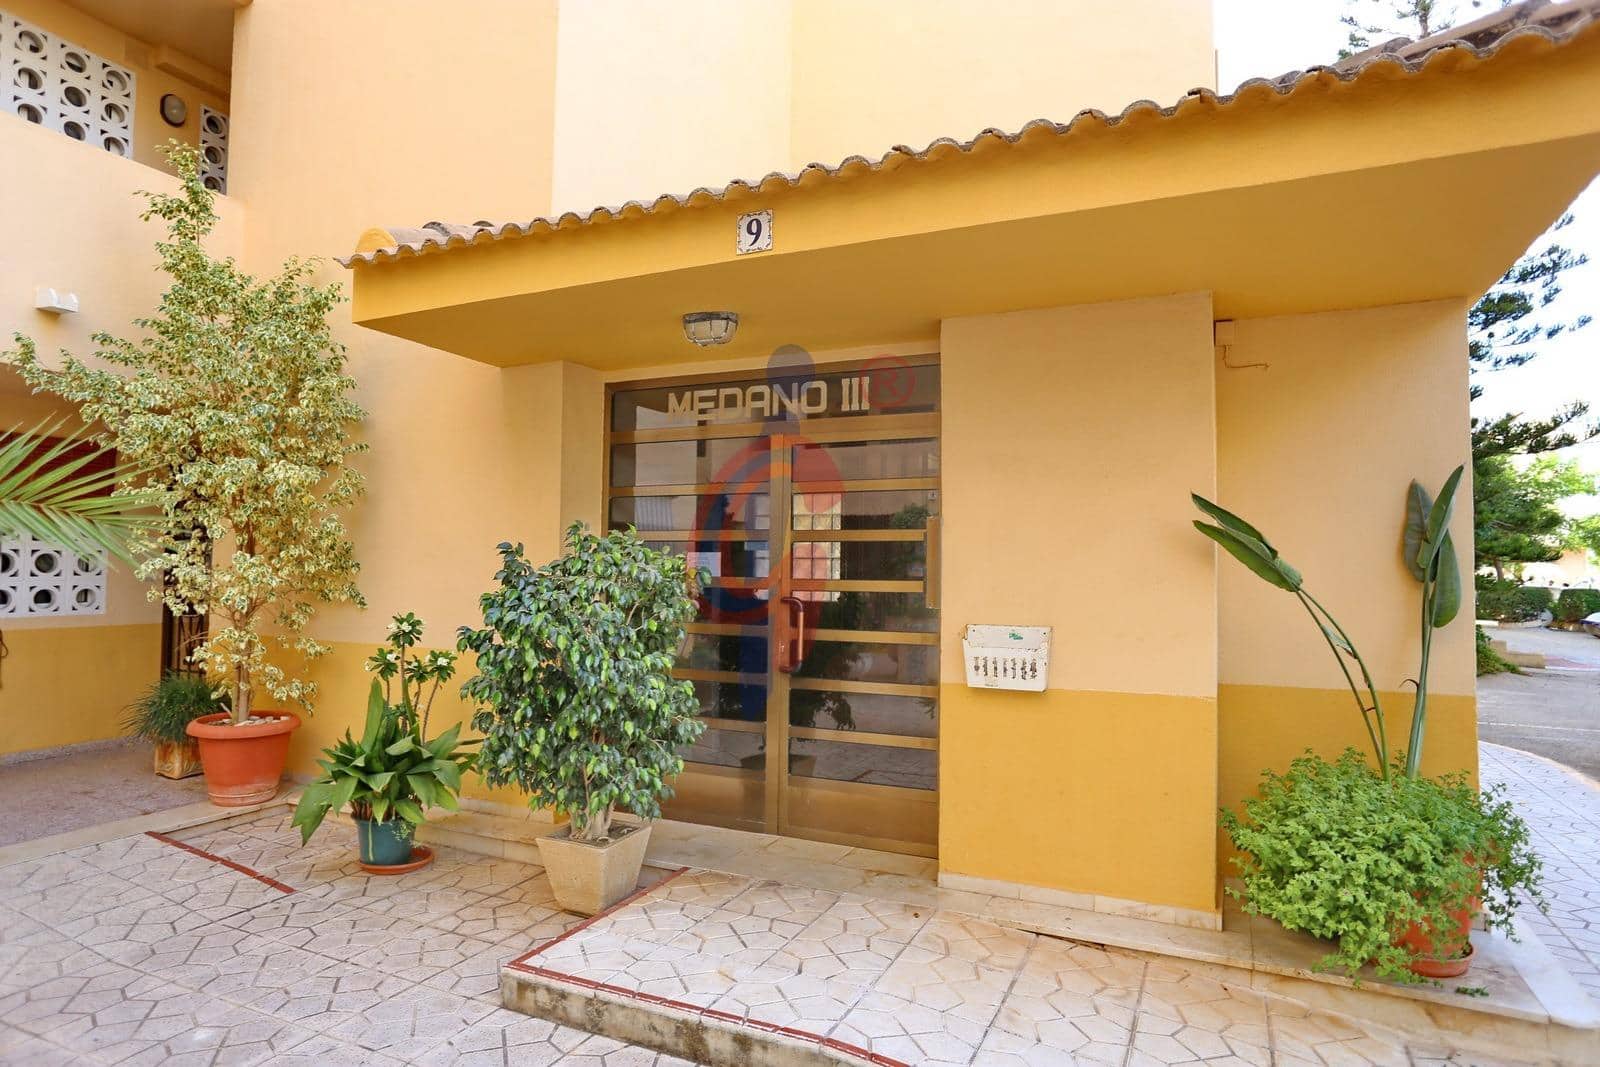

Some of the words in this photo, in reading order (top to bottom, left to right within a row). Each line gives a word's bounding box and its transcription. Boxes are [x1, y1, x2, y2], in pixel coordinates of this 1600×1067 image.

[747, 218, 762, 247] 9
[667, 381, 827, 420] MEDANO
[841, 376, 870, 411] III
